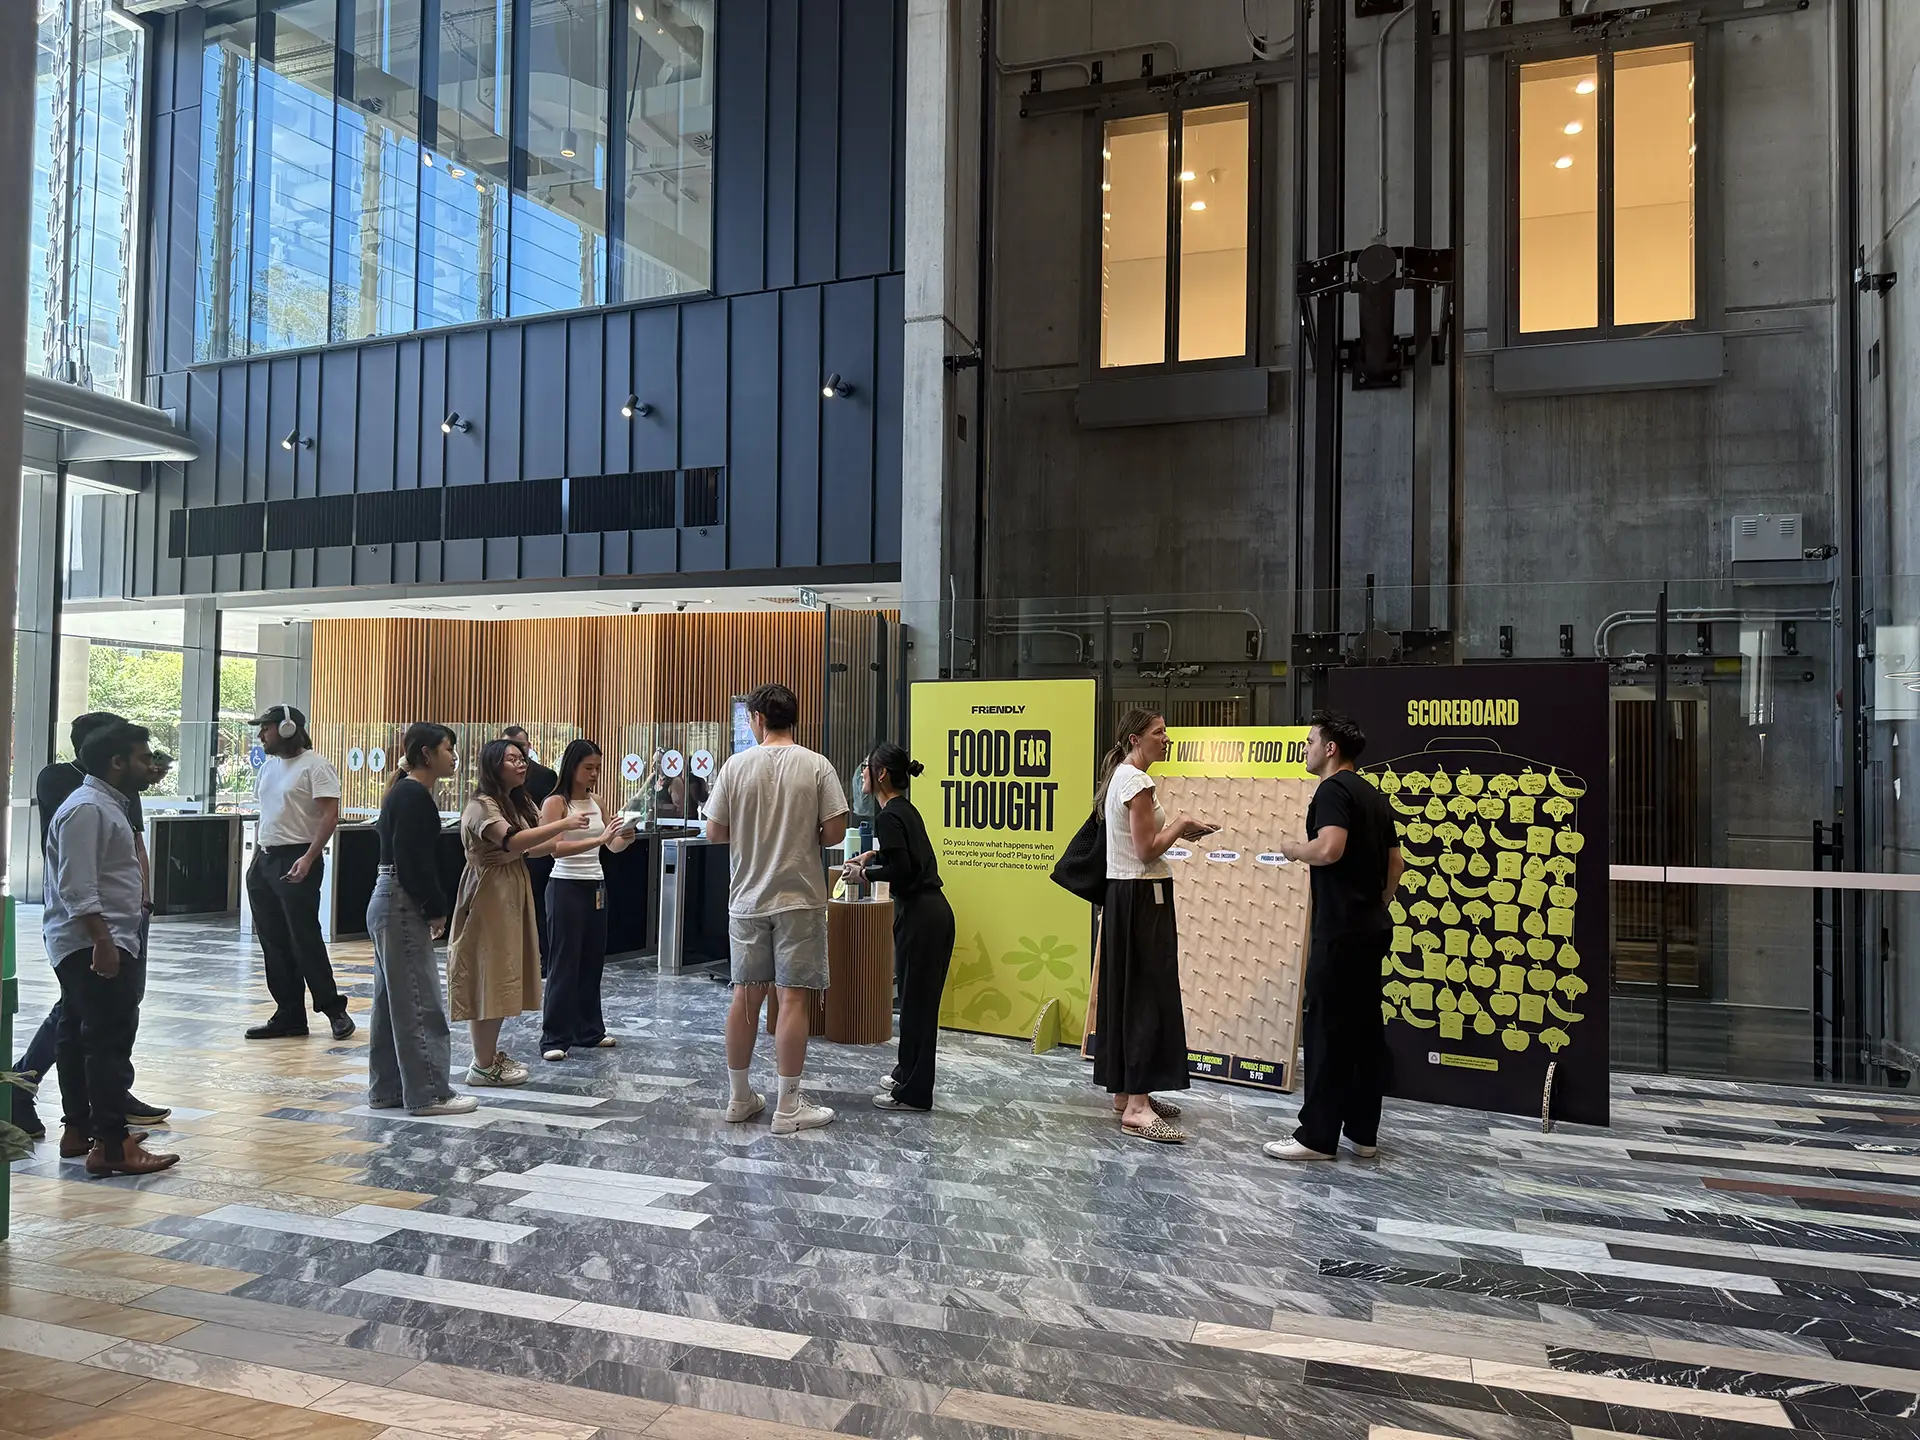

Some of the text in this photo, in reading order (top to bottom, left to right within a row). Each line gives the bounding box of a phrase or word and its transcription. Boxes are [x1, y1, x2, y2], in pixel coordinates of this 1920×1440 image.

[1407, 699, 1519, 726] SCOREBOARD
[948, 729, 1010, 777] FOOD
[1177, 741, 1205, 762] WILL
[1210, 741, 1244, 762] YOUR
[1248, 741, 1283, 763] FOOD
[941, 780, 1058, 831] THOUGHT
[943, 838, 953, 846] Do
[986, 840, 1002, 848] what
[1003, 841, 1034, 849] happens
[1016, 852, 1032, 861] Play
[1041, 853, 1055, 861] find
[983, 861, 999, 869] your
[1033, 863, 1049, 871] win!
[1202, 1055, 1223, 1065] EMISSIONS
[1196, 1062, 1211, 1072] 20 PTS
[1240, 1061, 1275, 1073] PRODUCE ENERGY
[1255, 1072, 1264, 1080] PTS
